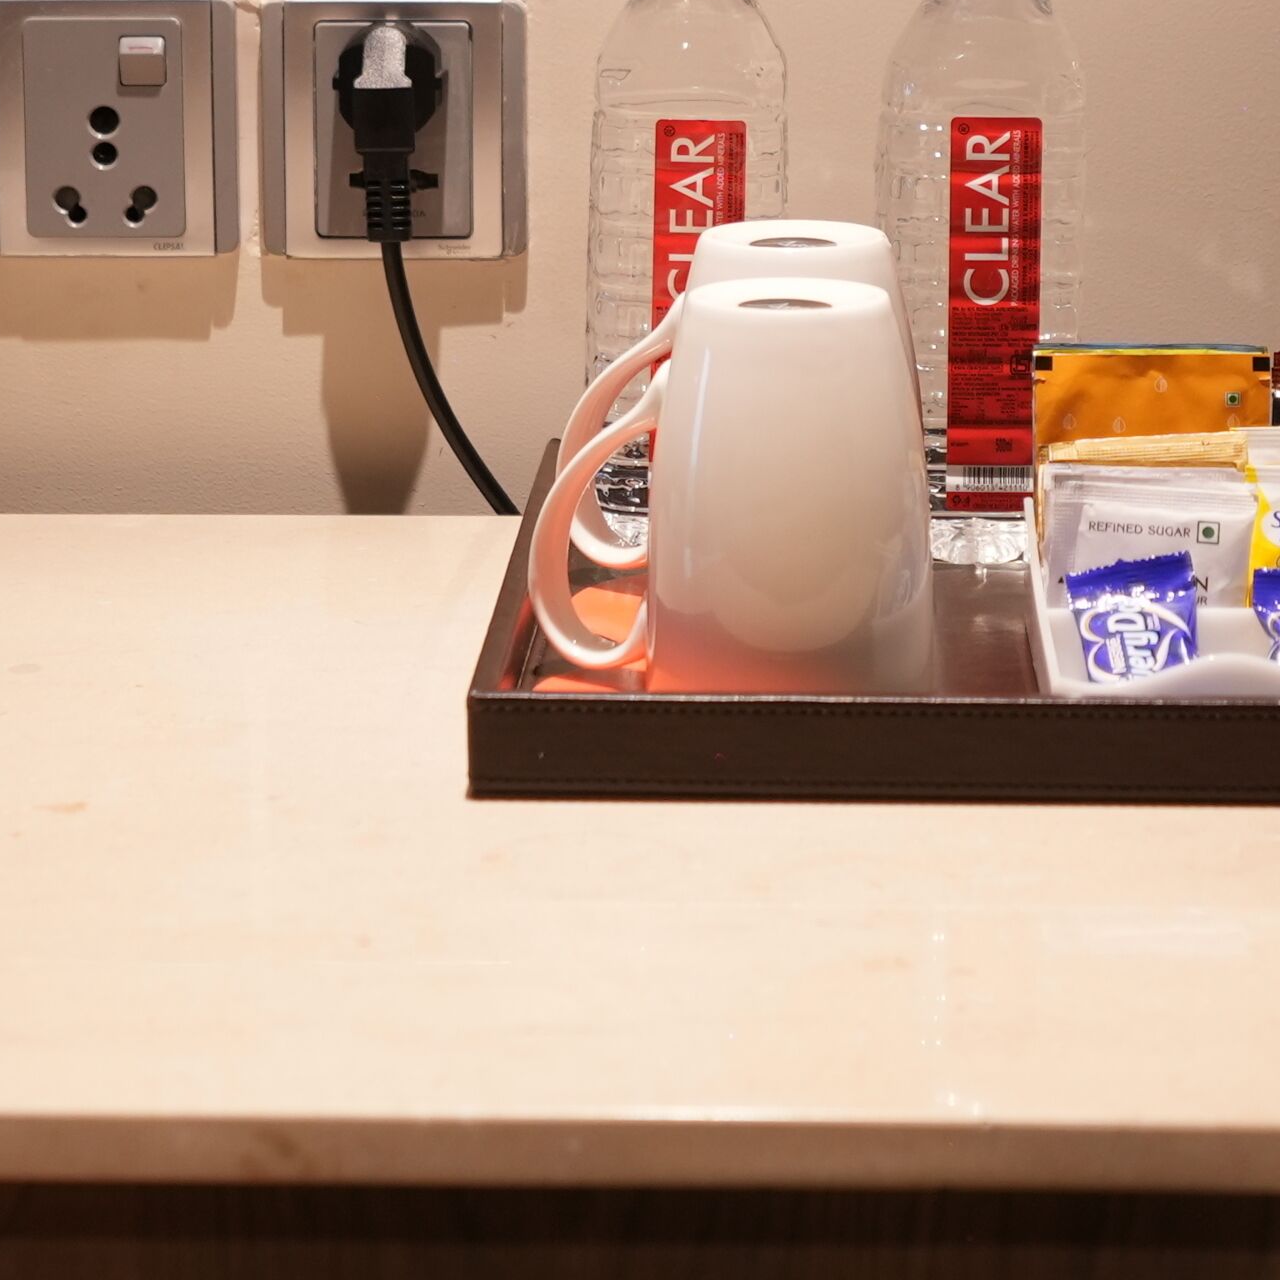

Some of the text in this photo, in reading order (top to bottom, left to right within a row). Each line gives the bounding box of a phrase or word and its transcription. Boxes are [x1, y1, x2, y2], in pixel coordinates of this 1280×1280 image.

[717, 166, 725, 190] ADDED
[963, 130, 1011, 306] CLEAR
[1010, 129, 1021, 306] PACKAGED DRINKING WATER WITH ADDED MINERALS
[1088, 521, 1191, 538] REFINED SUGAR
